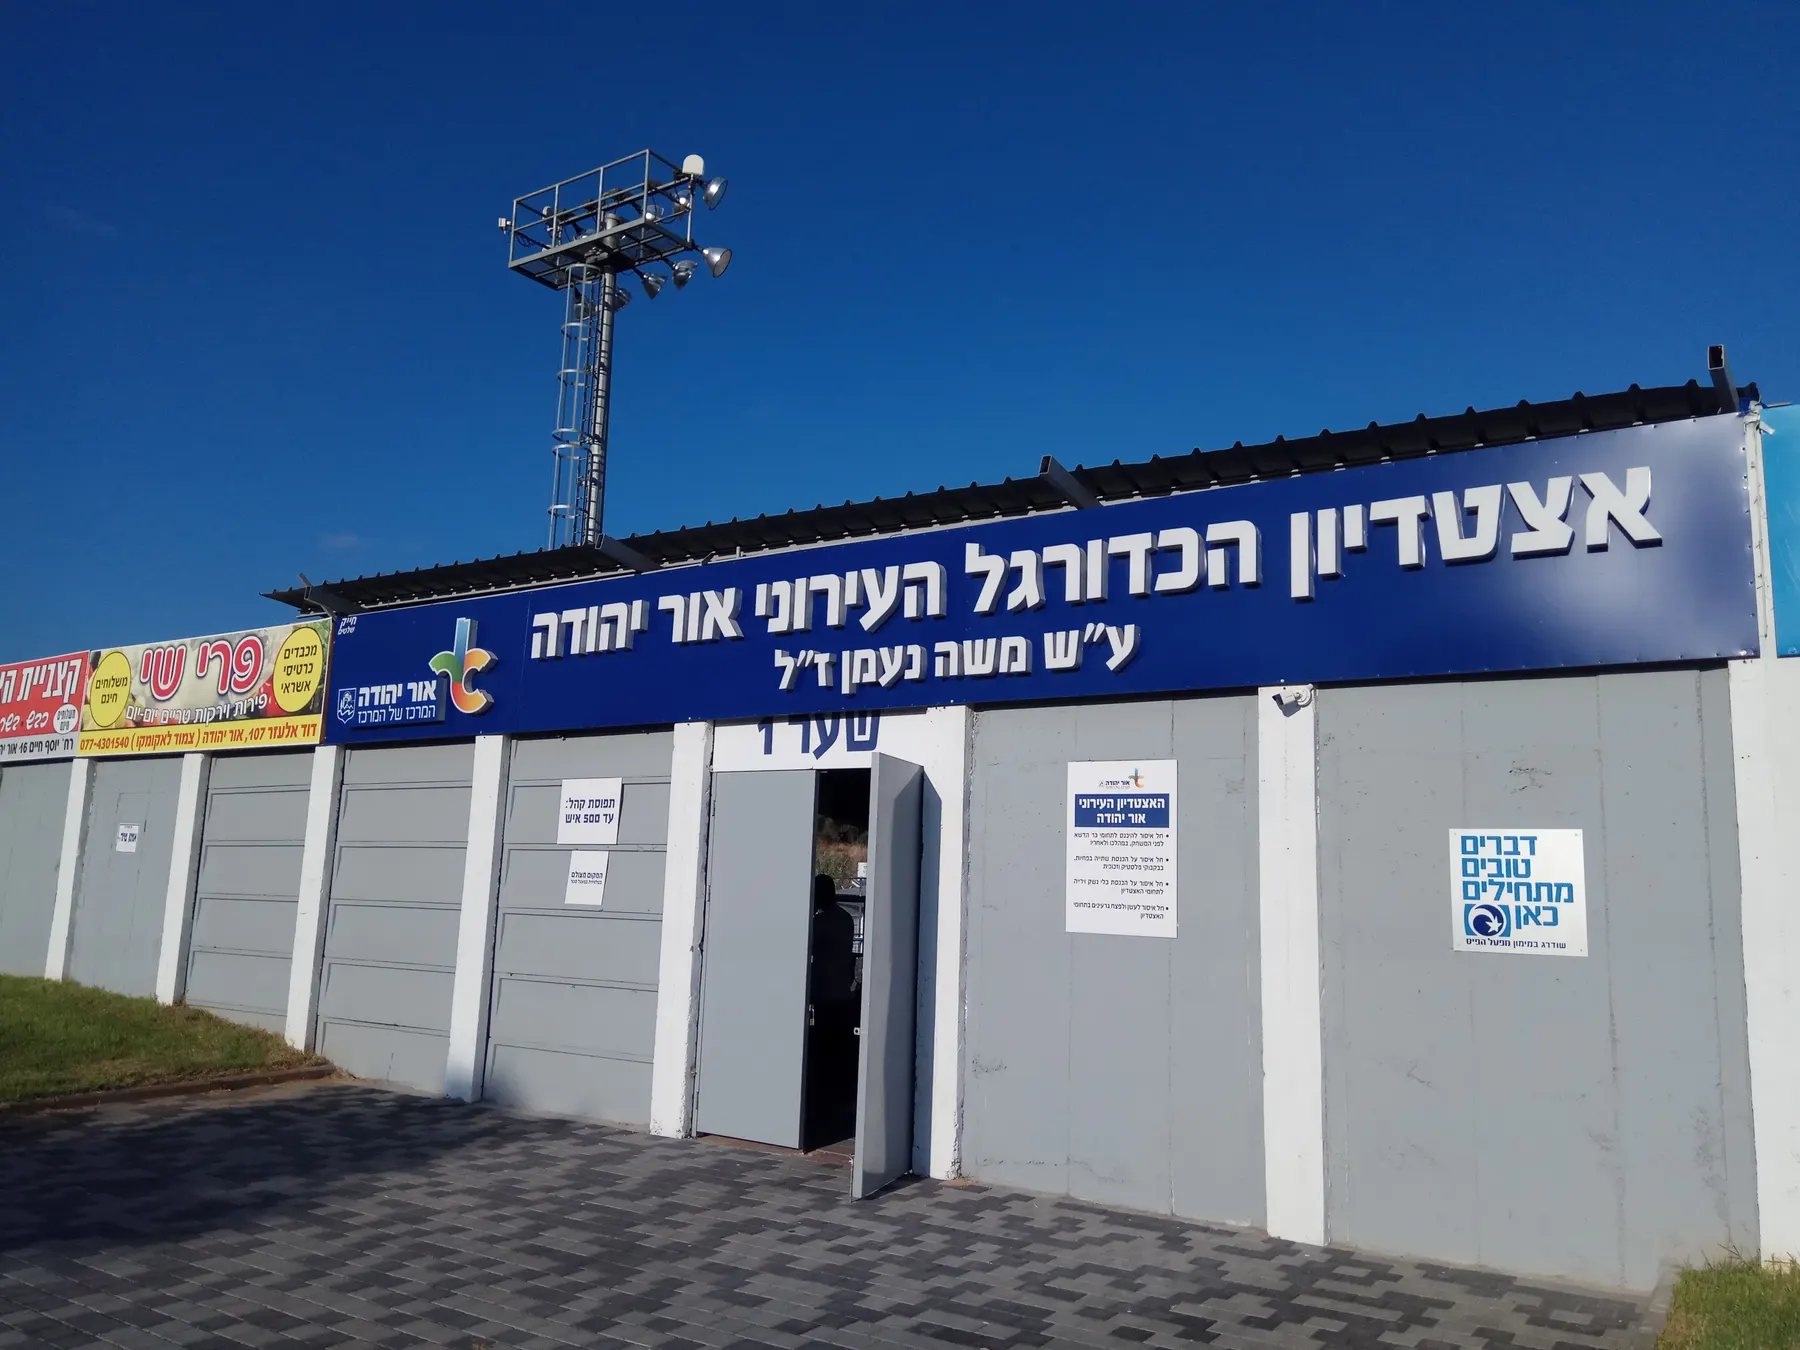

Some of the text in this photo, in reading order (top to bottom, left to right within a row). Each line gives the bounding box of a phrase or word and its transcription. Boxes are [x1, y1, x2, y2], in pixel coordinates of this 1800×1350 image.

[531, 466, 1663, 660] אצטדיון הכדורגל העירוני אור יהודה
[284, 644, 317, 660] מכבדים
[934, 636, 1032, 677] משה
[140, 635, 264, 701] פרי שי
[283, 662, 314, 676] כרטיסי
[841, 643, 926, 694] נעמן
[96, 675, 128, 690] משלוחים
[281, 680, 312, 694] אשראי
[101, 693, 118, 704] חינם
[358, 680, 437, 707] אור יהודה
[233, 693, 268, 717] פירות
[161, 708, 191, 724] טריים
[193, 703, 230, 727] וירקות
[358, 704, 436, 723] המרכז של המרכז
[202, 729, 227, 744] יהודה
[229, 729, 244, 742] אור
[268, 722, 299, 739] אלעזר
[301, 723, 317, 738] דוד
[788, 709, 881, 760] שער
[7, 743, 18, 755] אור
[19, 742, 28, 754] 16
[29, 741, 43, 753] חיים
[45, 739, 60, 755] יוסף
[80, 736, 129, 751] 077-4301540
[565, 797, 615, 811] תפוסת קהל:
[1079, 798, 1165, 811] האצטדיון העירוני
[565, 813, 614, 824] עד 500 איש
[1096, 812, 1146, 824] אור יהודה
[1460, 835, 1538, 856] דברים
[1461, 857, 1532, 878] טובים
[1462, 879, 1574, 903] מתחילים
[1515, 904, 1559, 930] כאן
[1466, 938, 1487, 946] הפיס
[1487, 938, 1511, 947] מפעל
[1513, 940, 1539, 949] במימון
